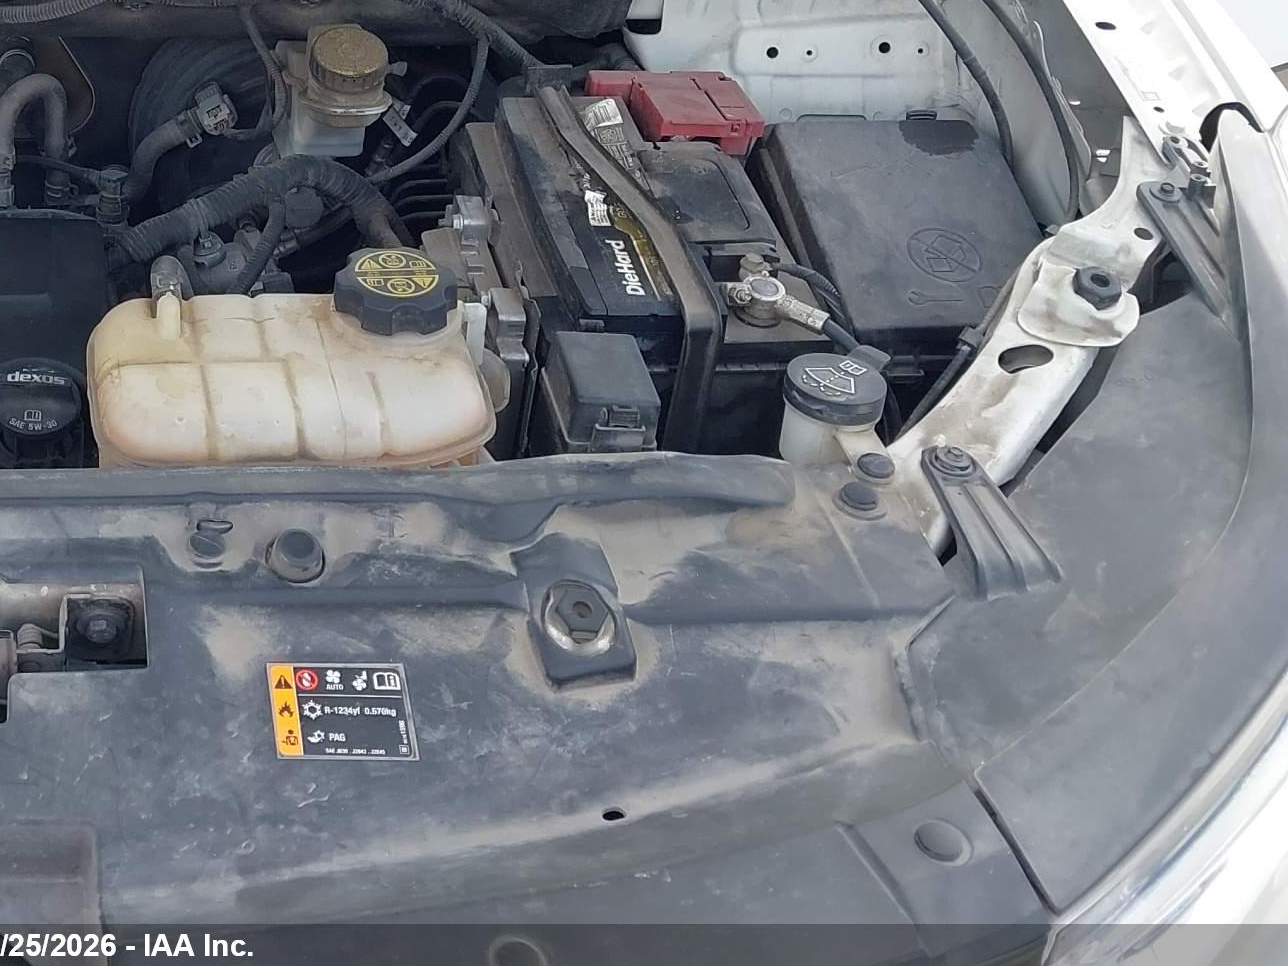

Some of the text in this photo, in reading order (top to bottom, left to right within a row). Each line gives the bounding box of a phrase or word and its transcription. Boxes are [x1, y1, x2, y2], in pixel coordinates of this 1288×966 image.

[604, 239, 646, 297] DieHard
[7, 371, 68, 385] dexos
[9, 418, 57, 430] SAE 5W-30
[324, 706, 360, 716] R-1234yf
[329, 733, 346, 742] PAG
